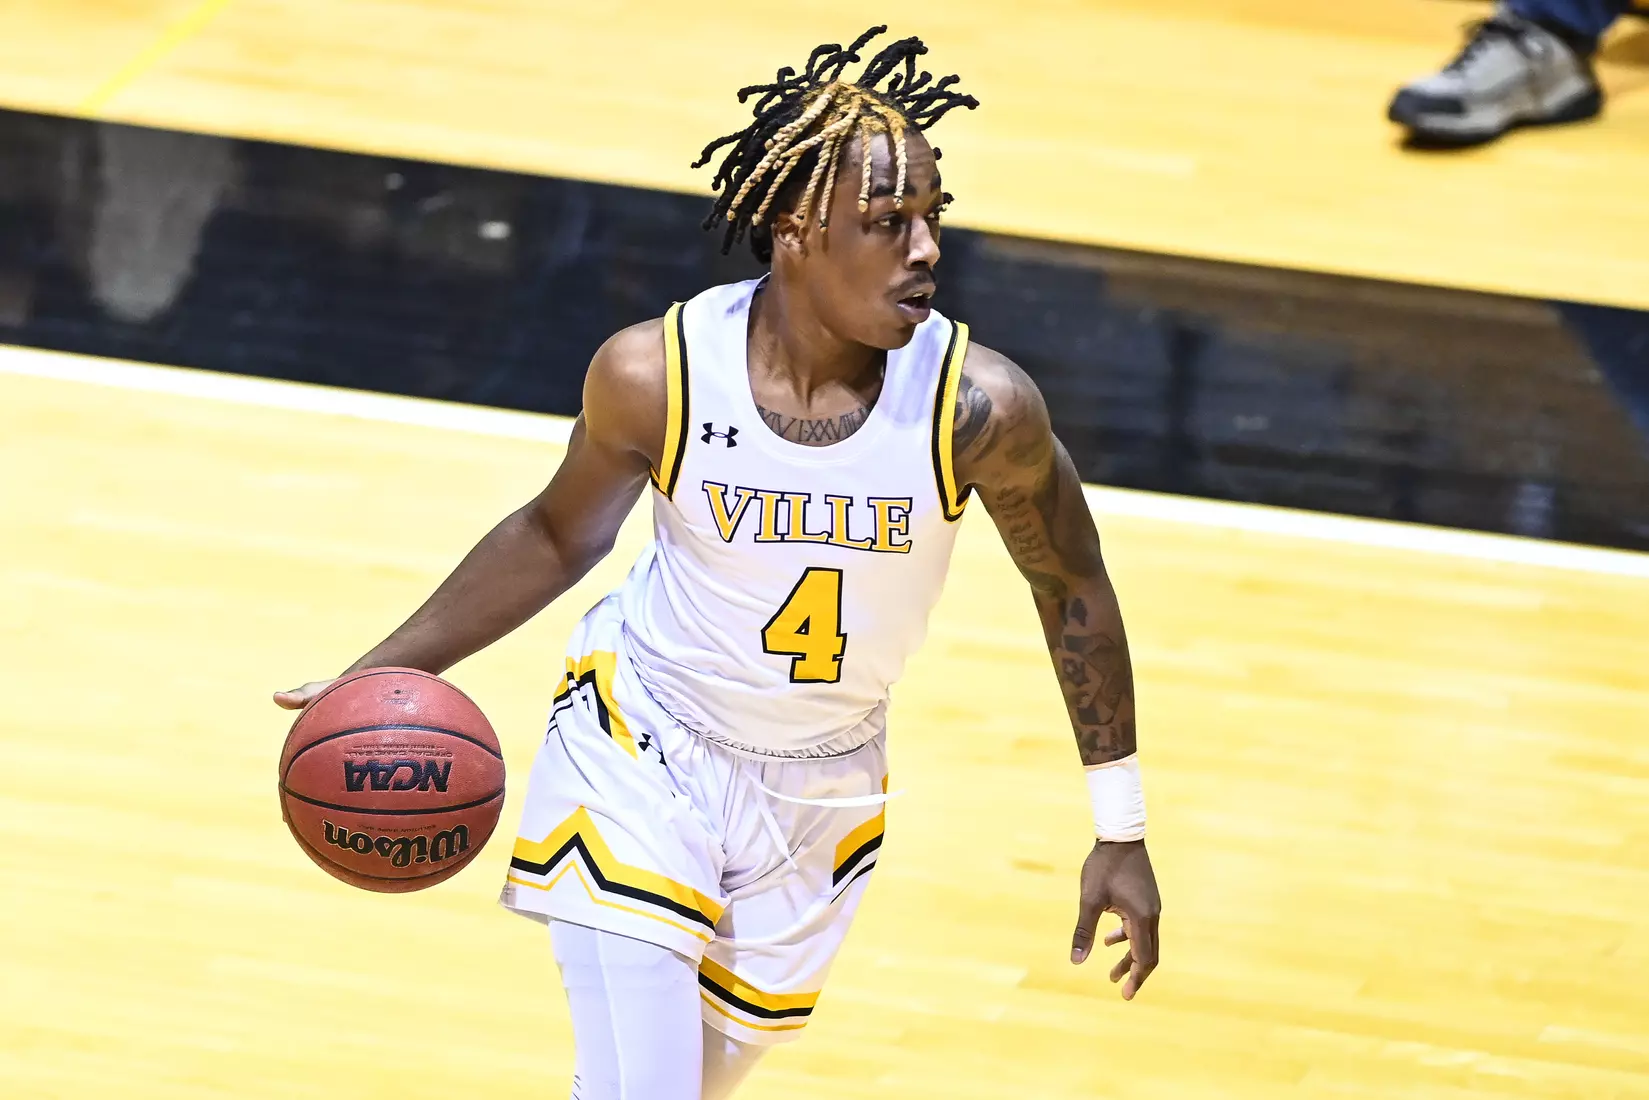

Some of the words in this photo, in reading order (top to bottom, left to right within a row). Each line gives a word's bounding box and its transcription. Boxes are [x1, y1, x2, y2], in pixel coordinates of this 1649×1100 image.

[702, 480, 913, 553] VILLE
[761, 567, 847, 684] 4
[343, 759, 453, 793] NCAA
[322, 819, 471, 868] Wilson
